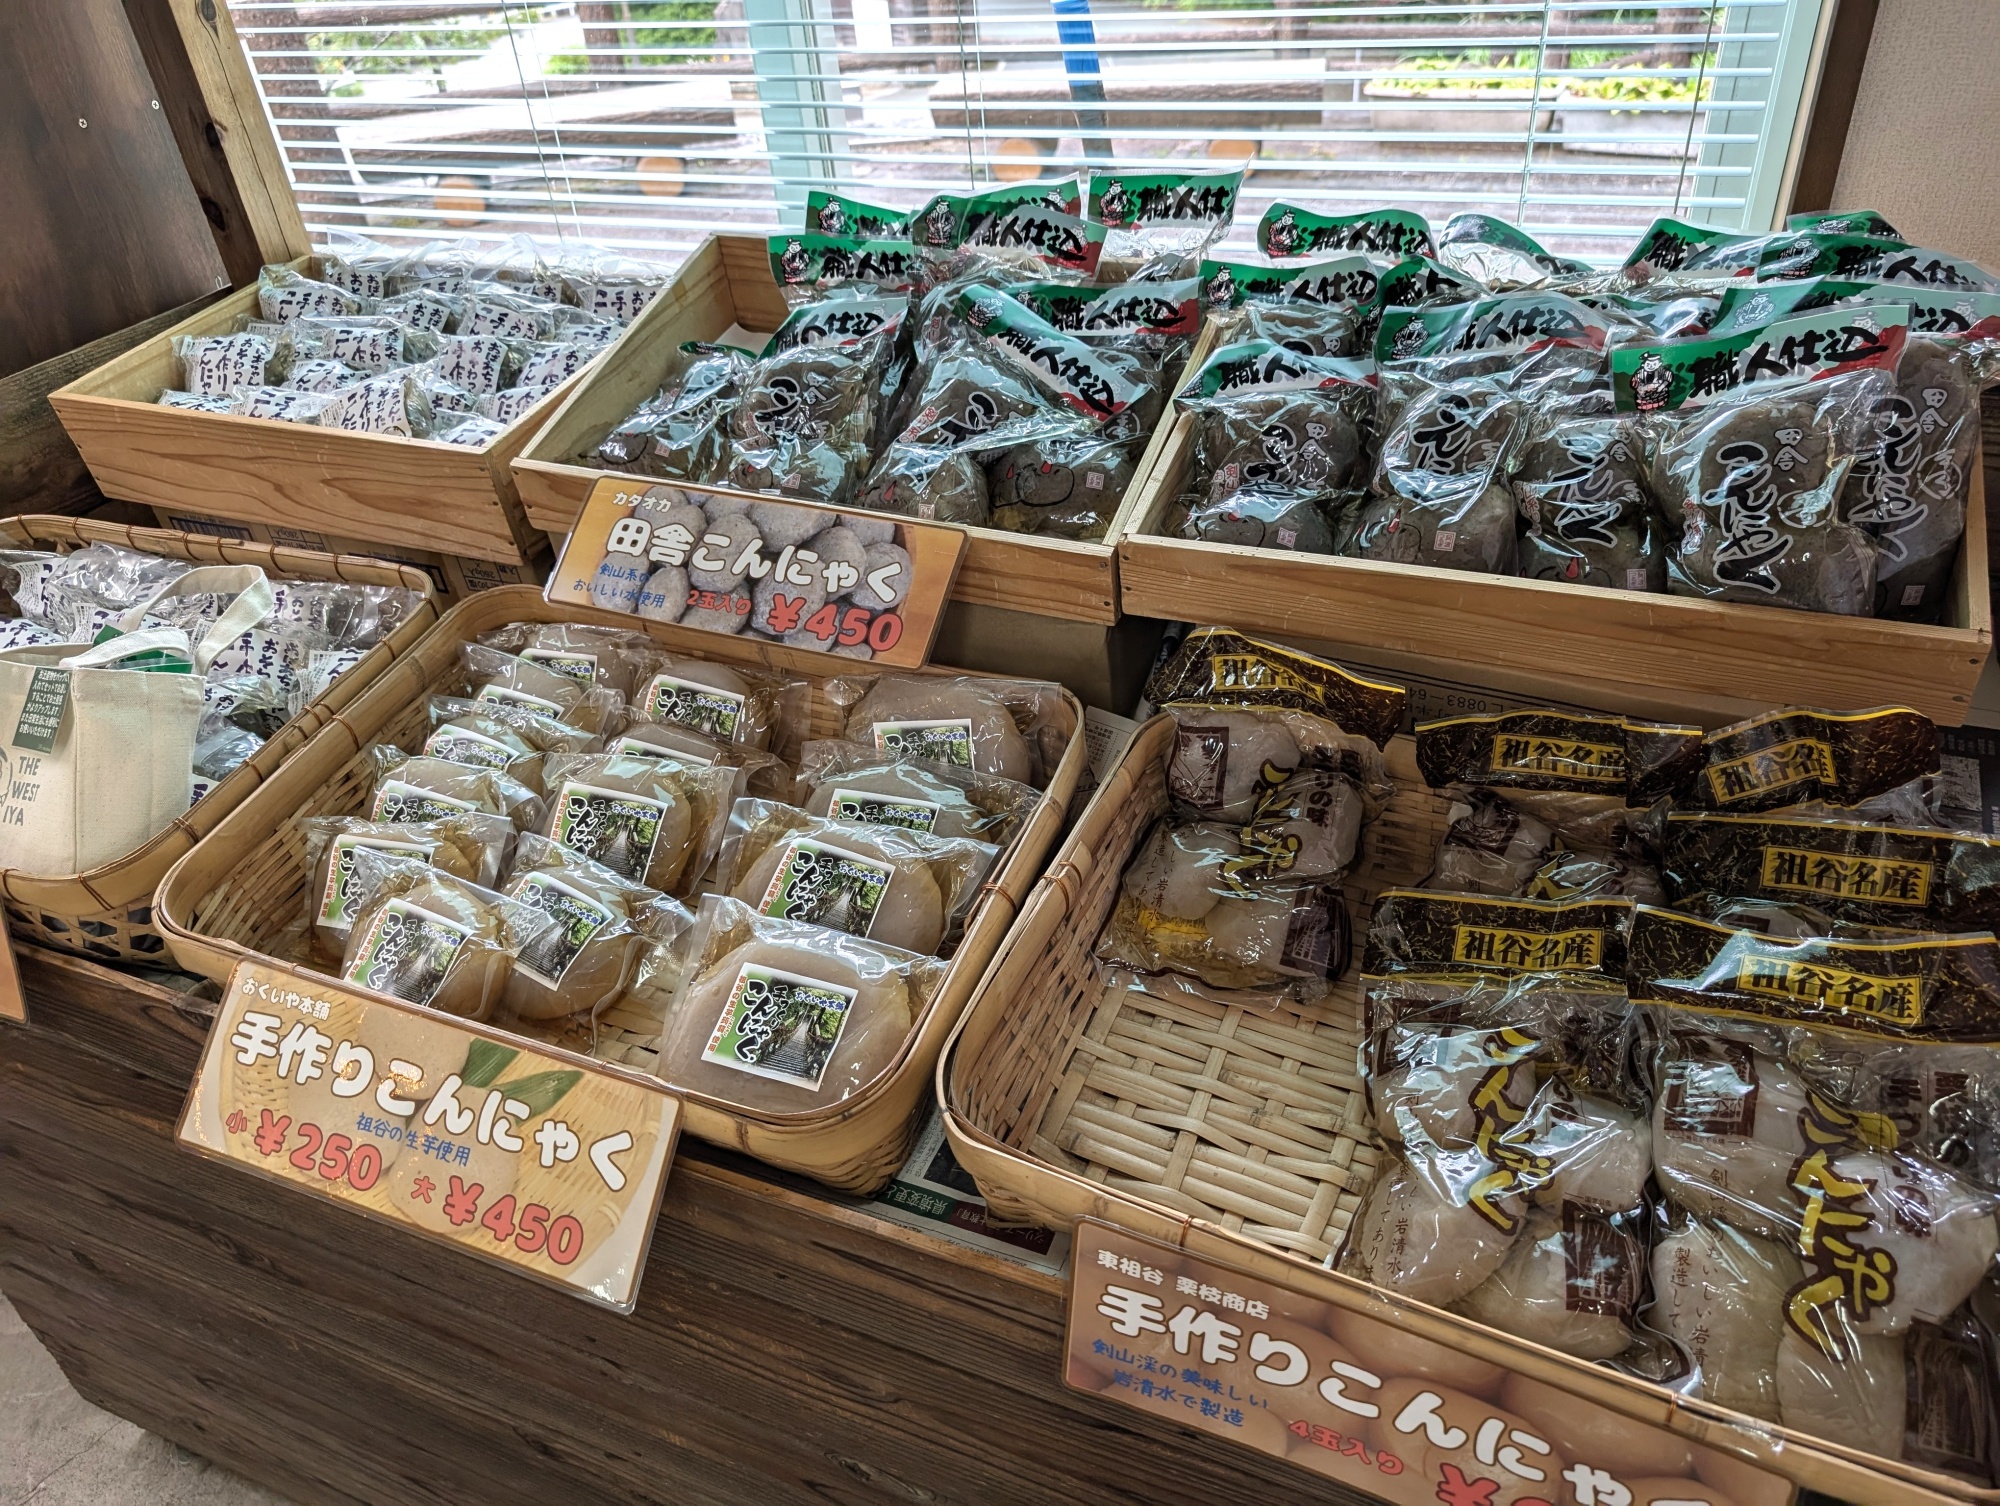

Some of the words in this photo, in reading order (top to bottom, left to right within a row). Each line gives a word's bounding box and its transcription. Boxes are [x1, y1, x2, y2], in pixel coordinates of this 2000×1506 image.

[820, 246, 912, 279] 職人仕
[968, 217, 1088, 262] 職人仕込
[1052, 297, 1187, 334] 職人仕込
[998, 325, 1118, 419] 職人仕込
[1689, 326, 1889, 398] 職人仕込
[1920, 387, 1950, 434] 田舎
[1774, 428, 1809, 472] 田舎
[612, 491, 672, 513] カタオカ
[599, 562, 651, 586] 剣山系の
[606, 517, 903, 603] 田舎こんにゃく
[573, 579, 665, 609] おいしい水使用
[686, 589, 751, 616] 2玉入り
[768, 594, 904, 652] ¥450
[19, 756, 42, 776] THE
[11, 781, 41, 803] WEST
[2, 805, 24, 827] IYA
[1770, 851, 1921, 901] 祖谷名産
[1461, 930, 1595, 967] 祖谷名産
[241, 976, 332, 1021] おくいや本舗
[1751, 960, 1916, 1019] 祖谷名産
[230, 1009, 634, 1192] 手作りこんにゃく
[225, 1108, 248, 1135] 小
[253, 1107, 383, 1192] ¥250
[356, 1111, 471, 1168] 祖谷の生芋使用
[410, 1175, 437, 1204] 大
[443, 1174, 585, 1266] ¥450
[1096, 1249, 1164, 1286] 東祖谷
[1097, 1283, 1712, 1506] 手作りこんにゃ
[1113, 1368, 1245, 1428] 岩清水で製造
[1288, 1418, 1405, 1477] 4玉入り
